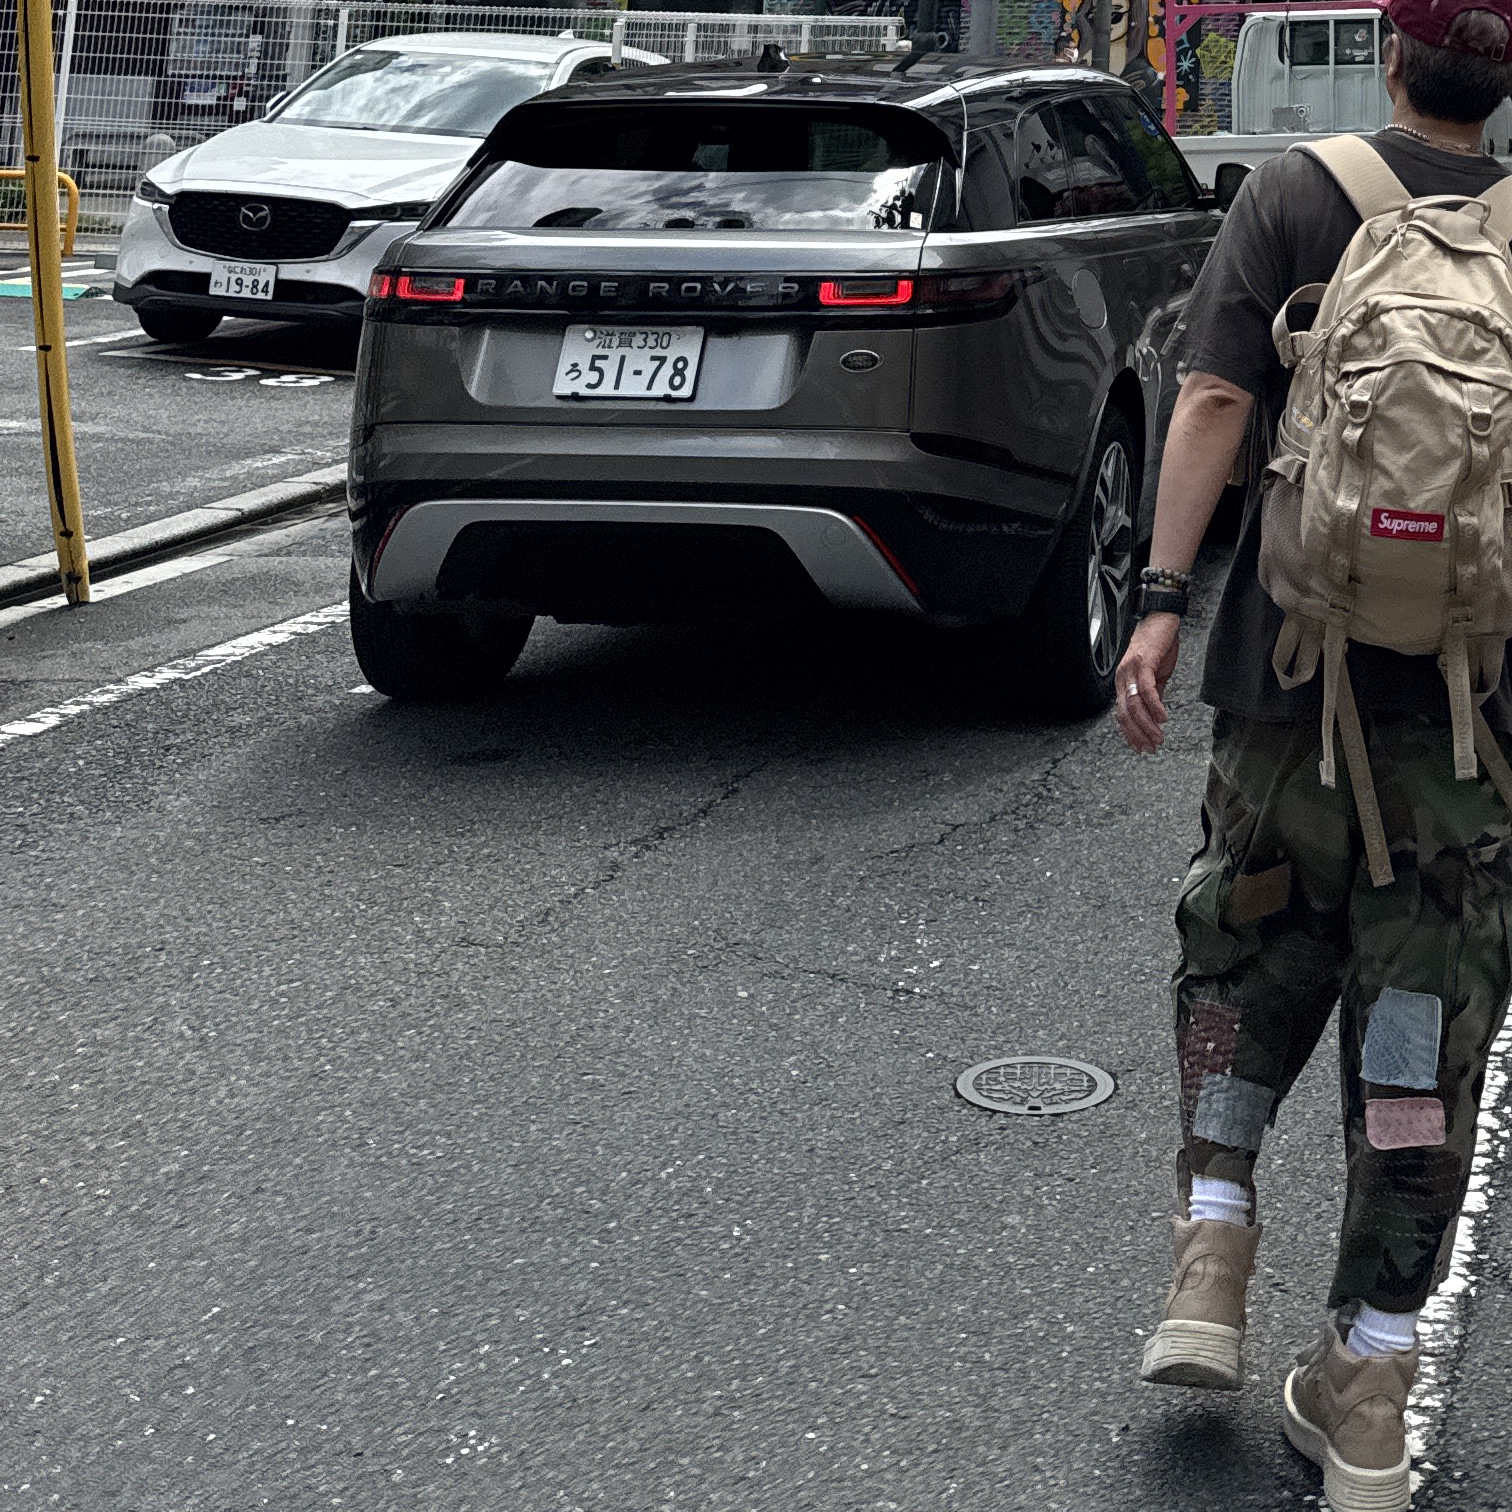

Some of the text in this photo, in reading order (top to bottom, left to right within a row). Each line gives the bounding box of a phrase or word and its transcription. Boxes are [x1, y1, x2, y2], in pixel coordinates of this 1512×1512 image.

[213, 276, 271, 297] わ 19-84
[476, 278, 800, 298] RANGE ROVER
[596, 329, 672, 350] 滋賀330
[564, 354, 690, 392] ろ 51-78
[1378, 512, 1438, 535] Supreme
